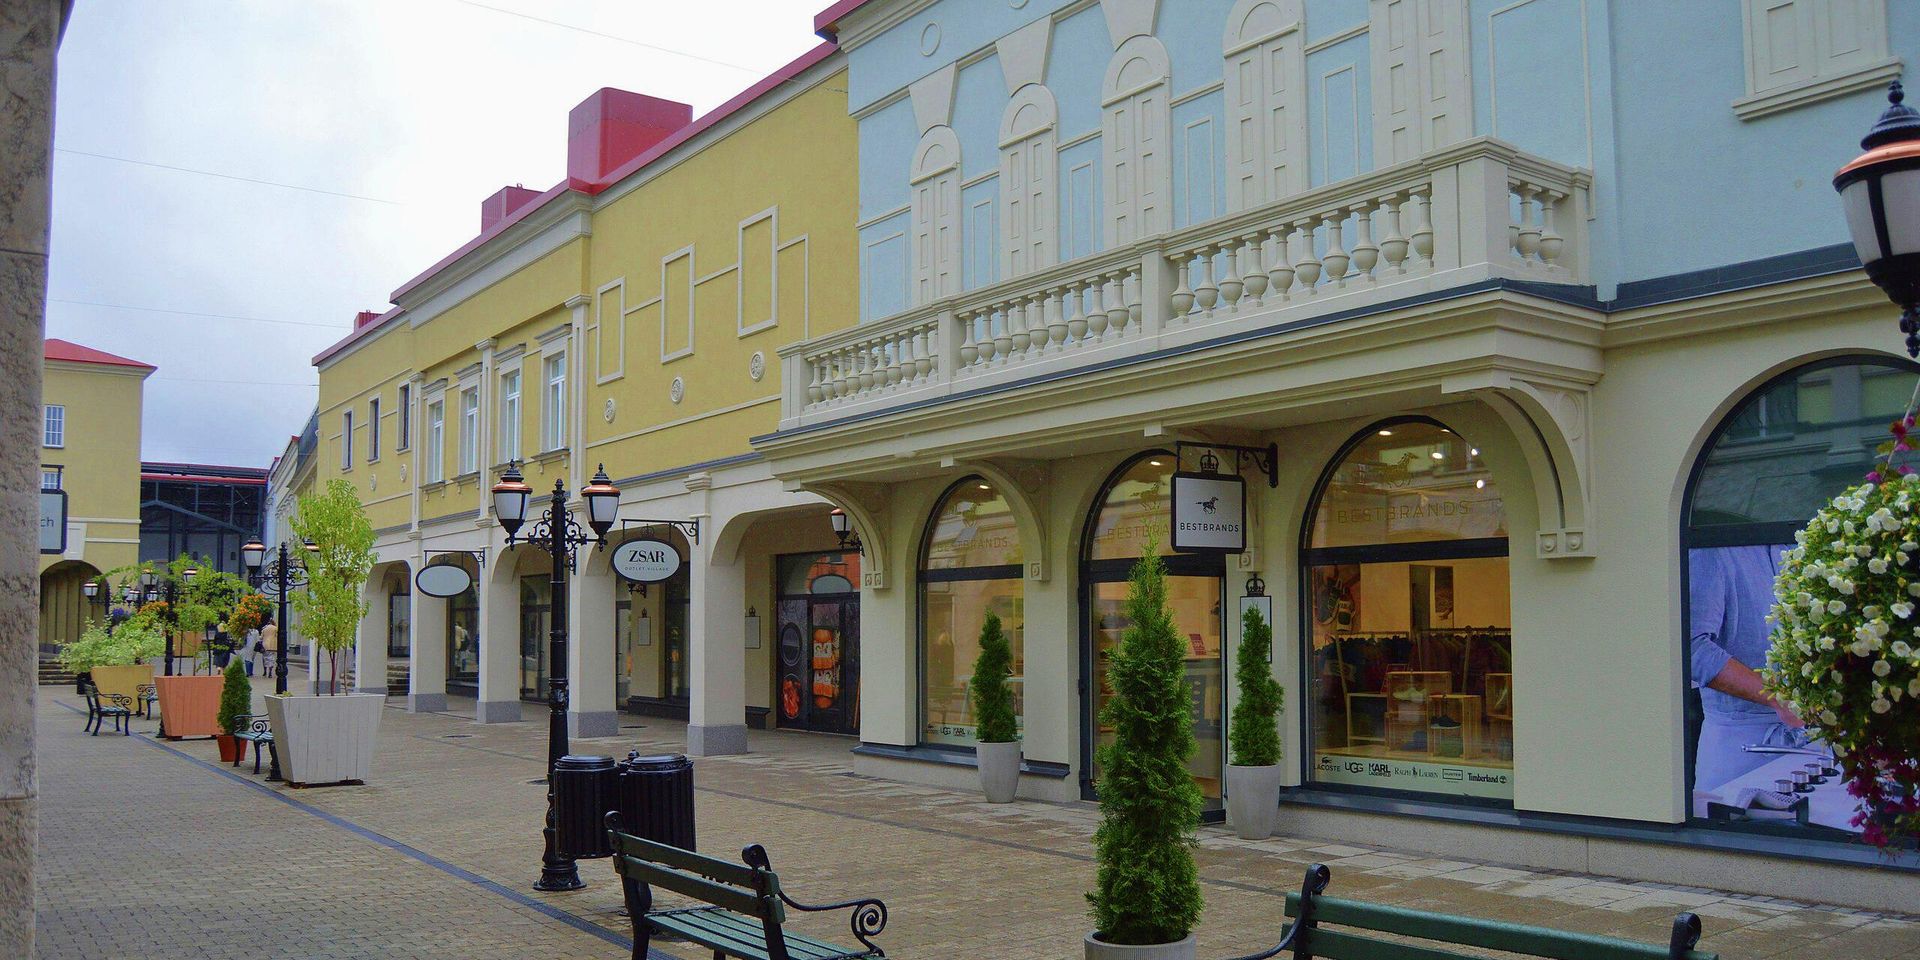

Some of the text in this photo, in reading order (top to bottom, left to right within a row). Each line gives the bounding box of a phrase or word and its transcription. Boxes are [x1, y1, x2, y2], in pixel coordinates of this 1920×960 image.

[1337, 500, 1471, 524] BESTBRANDS
[40, 516, 55, 527] ch
[1107, 523, 1170, 540] BESTBRA
[1180, 522, 1239, 533] BESTBRANDS
[629, 549, 665, 563] ZSAR
[1313, 764, 1341, 772] LACOSTE
[1344, 761, 1364, 774] UGG
[1368, 763, 1391, 773] KARL
[1467, 772, 1499, 783] Timberland
